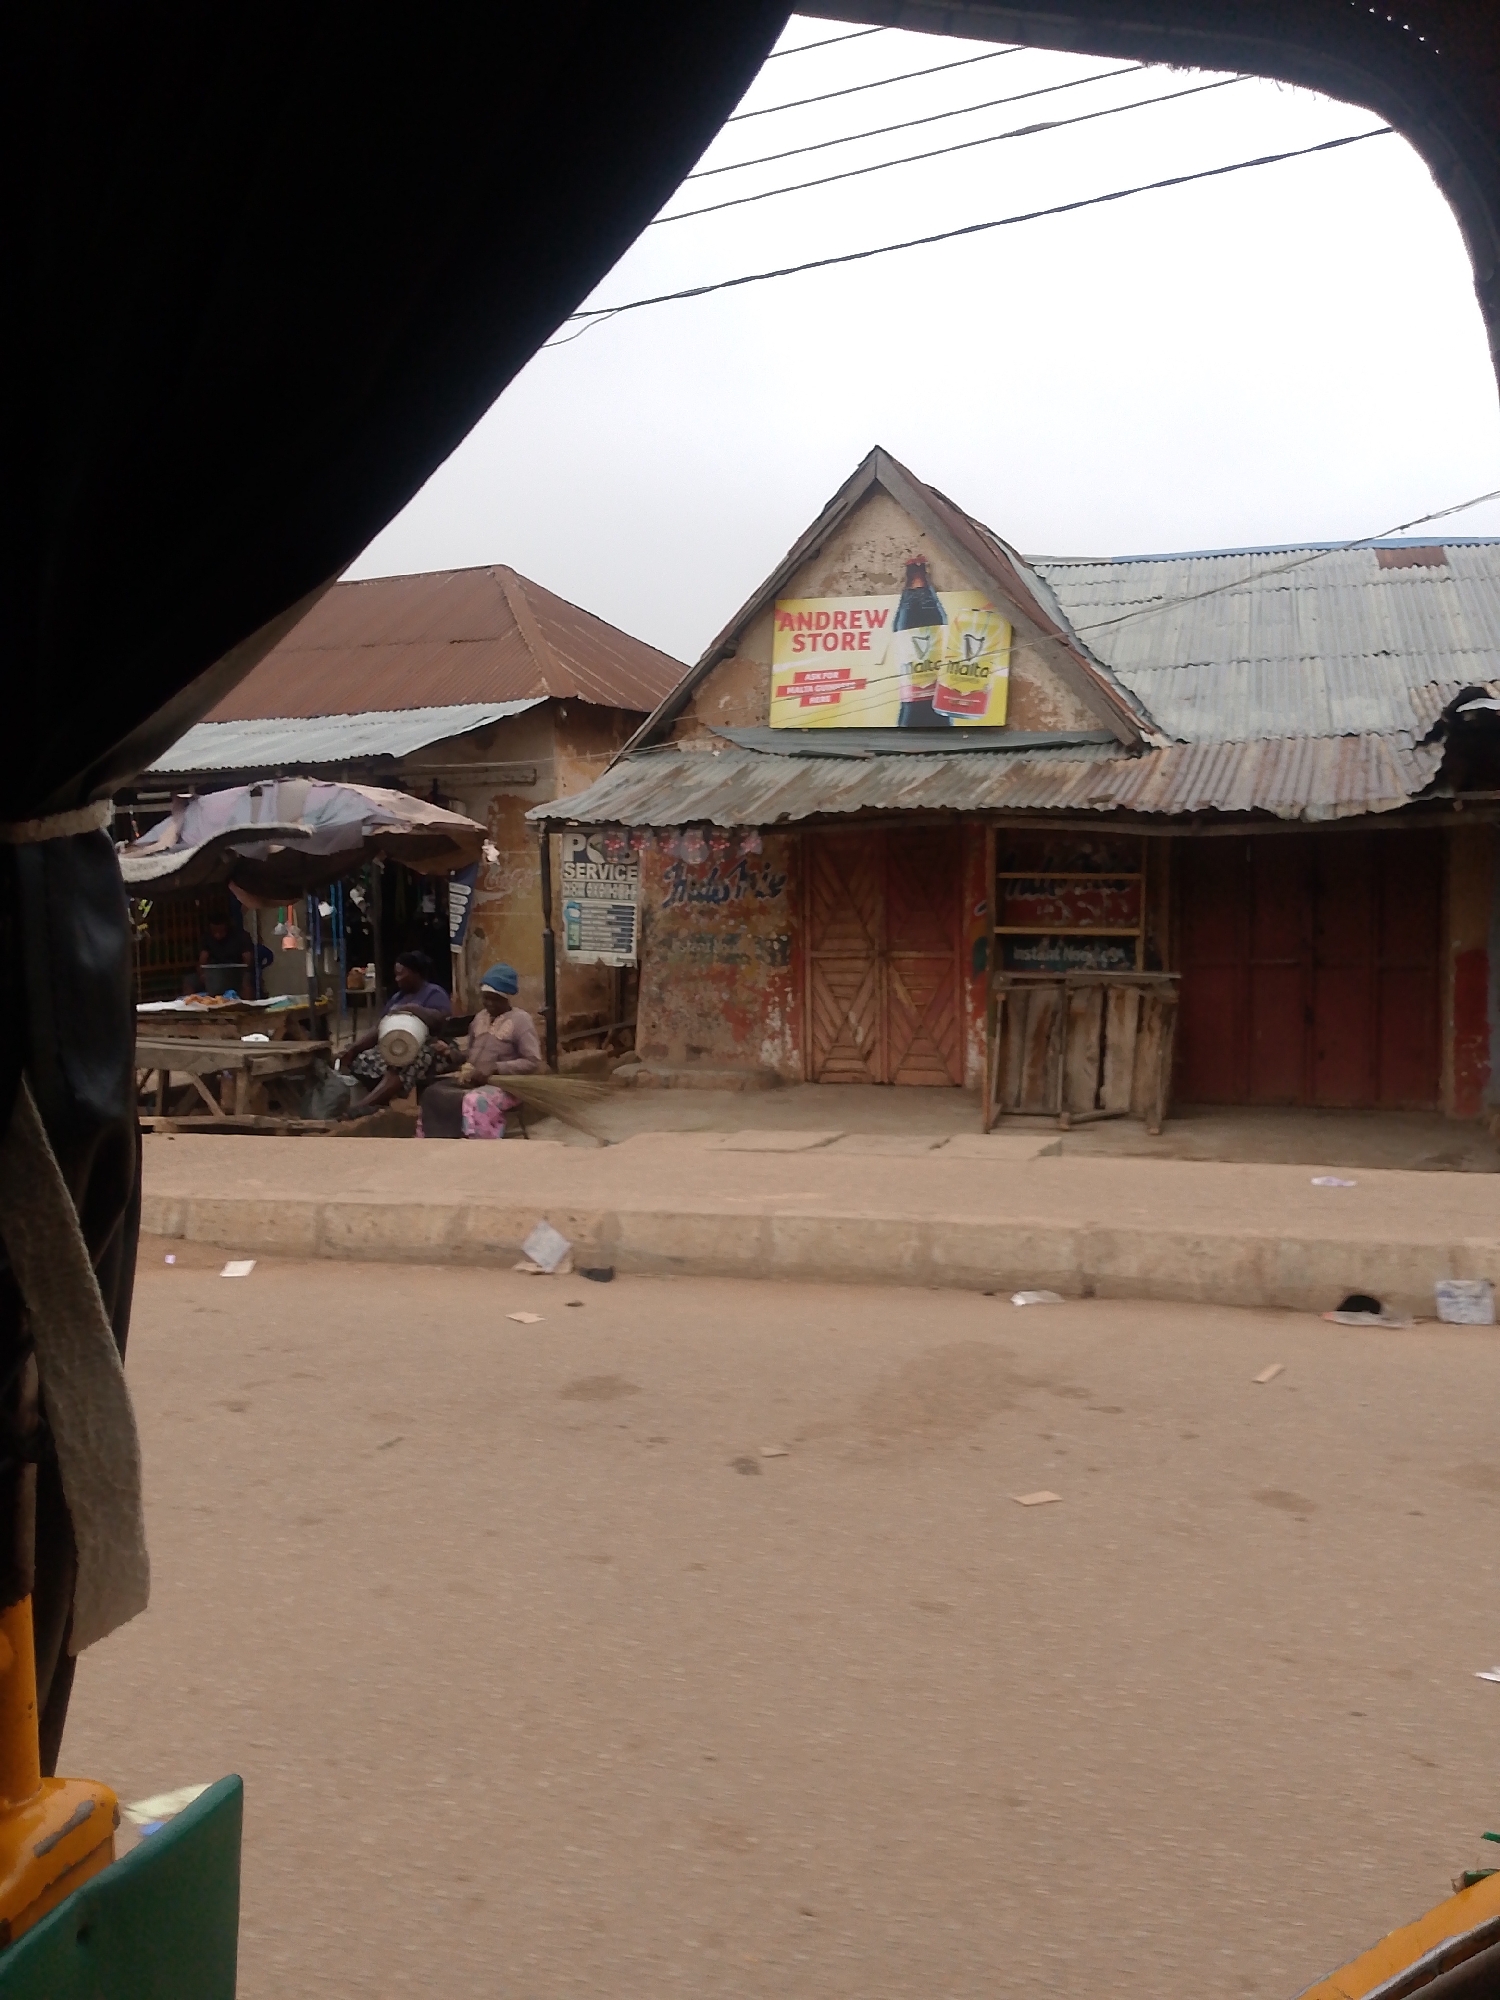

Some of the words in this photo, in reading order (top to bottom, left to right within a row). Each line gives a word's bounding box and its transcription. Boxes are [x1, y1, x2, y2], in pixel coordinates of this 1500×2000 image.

[778, 608, 889, 632] ANDREW
[792, 631, 872, 653] STORE
[804, 673, 821, 681] ASK
[822, 671, 839, 680] FOR
[786, 685, 813, 695] MALTA
[808, 695, 831, 704] HERE
[562, 862, 638, 881] SERVICE
